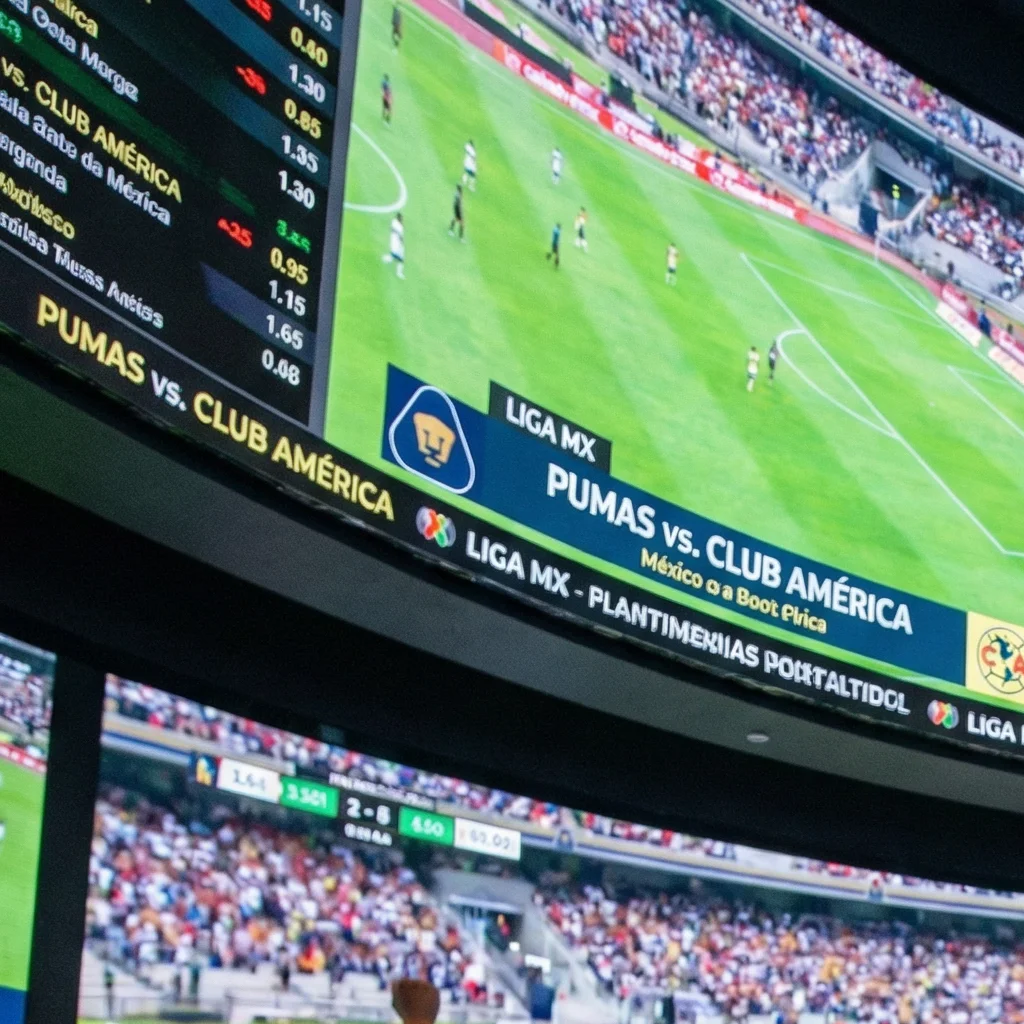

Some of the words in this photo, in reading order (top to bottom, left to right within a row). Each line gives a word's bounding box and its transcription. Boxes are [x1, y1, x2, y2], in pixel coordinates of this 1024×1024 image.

[288, 64, 326, 103] 1.30
[35, 80, 90, 136] CLUB
[93, 125, 182, 203] AMÉRICA
[281, 135, 319, 173] 1.35
[270, 247, 309, 285] 0.95
[268, 279, 307, 316] 1.15
[266, 314, 304, 350] 1.65
[36, 294, 146, 385] PUMAS
[193, 391, 269, 453] CLUB
[271, 437, 395, 520] AMÉRICA
[506, 395, 555, 445] LIGA
[560, 430, 597, 463] MX
[466, 530, 525, 580] LIGA
[530, 559, 570, 598] MX
[547, 462, 656, 540] PUMAS
[706, 534, 782, 589] CLUB
[785, 566, 913, 635] AMÉRICA
[640, 547, 703, 589] México
[967, 710, 1017, 744] LIGA
